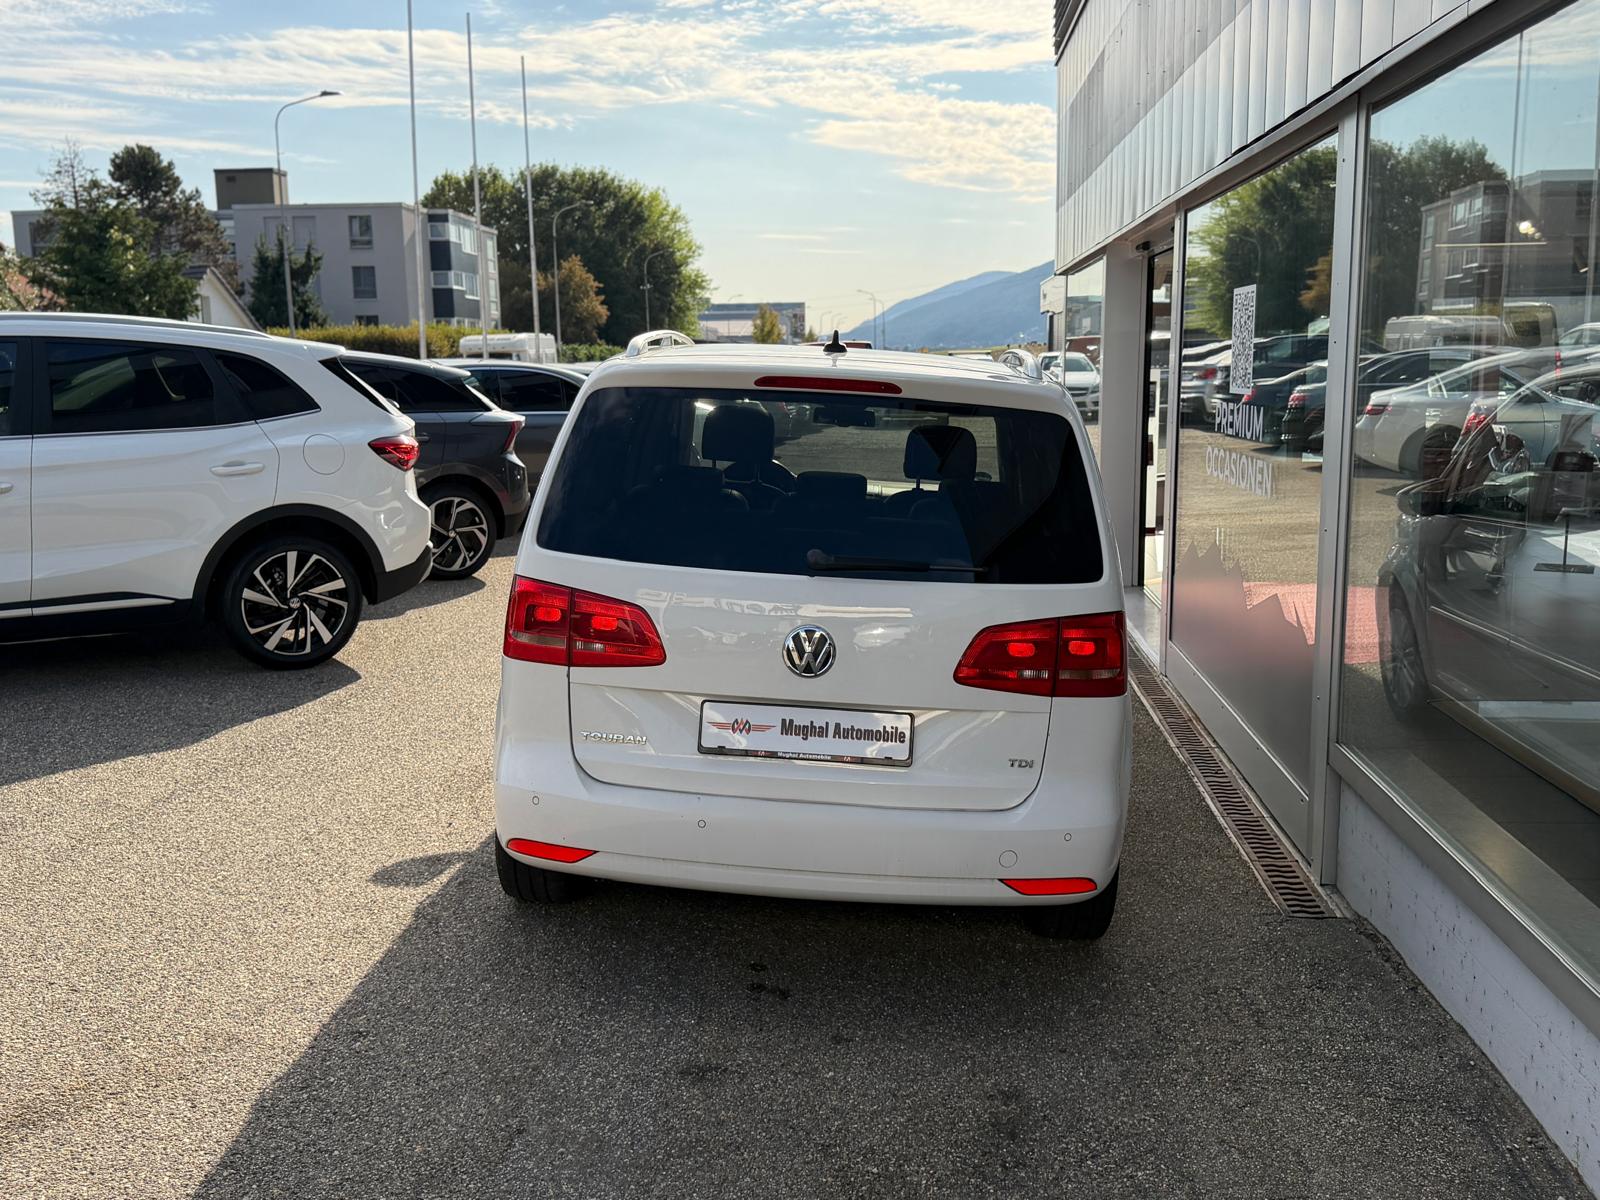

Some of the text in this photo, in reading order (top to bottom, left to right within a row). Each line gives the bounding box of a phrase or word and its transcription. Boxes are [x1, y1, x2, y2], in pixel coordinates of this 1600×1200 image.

[1214, 401, 1264, 442] PREMIUM
[1205, 445, 1272, 499] OCCASIONEN
[783, 625, 836, 678] VW
[580, 730, 648, 745] TOURAN
[780, 718, 906, 744] Mughal Automobile
[777, 751, 832, 761] Mughal Automobile
[1008, 758, 1034, 769] TDI
